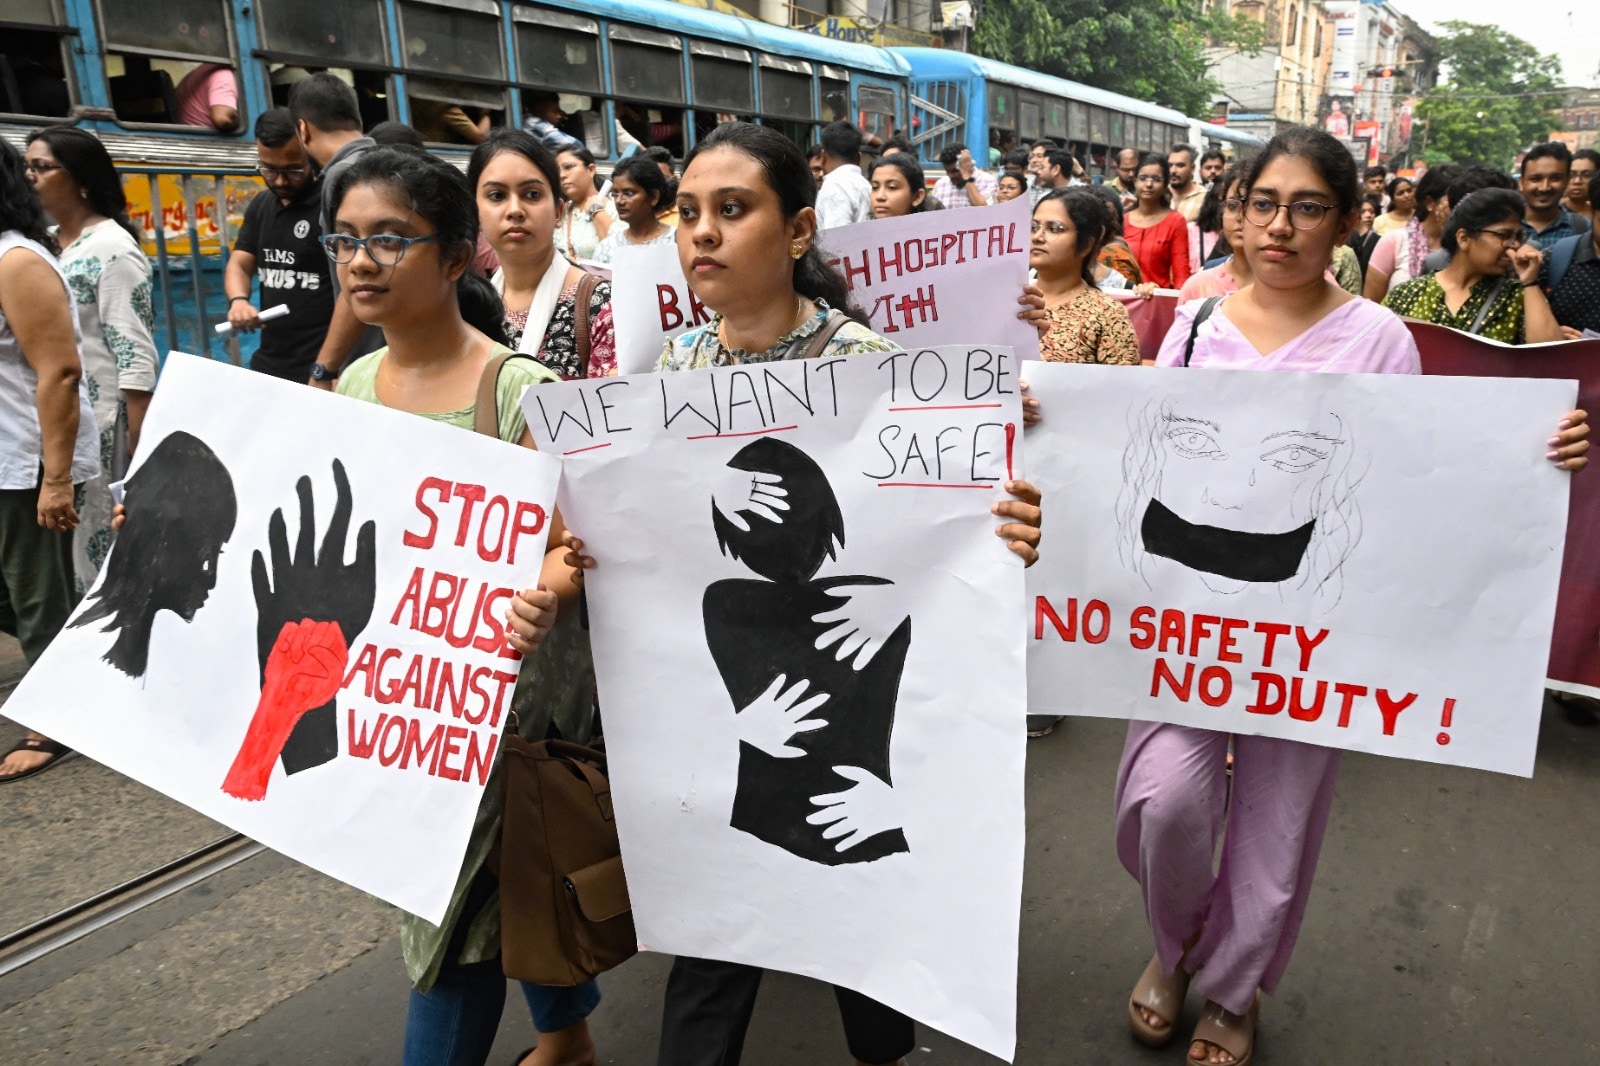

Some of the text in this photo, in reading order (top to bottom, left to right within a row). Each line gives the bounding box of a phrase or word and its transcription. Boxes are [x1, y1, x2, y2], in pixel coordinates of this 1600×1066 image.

[826, 249, 871, 291] H
[879, 223, 1023, 282] HOSPITAL
[536, 349, 1014, 442] WE WANT TO BE
[403, 476, 548, 565] STOP
[1035, 595, 1330, 672] NO SAFETY
[342, 643, 518, 728] AGAINST
[1151, 657, 1233, 708] NO
[1245, 671, 1418, 737] DUTY
[348, 708, 499, 787] WOMEN
